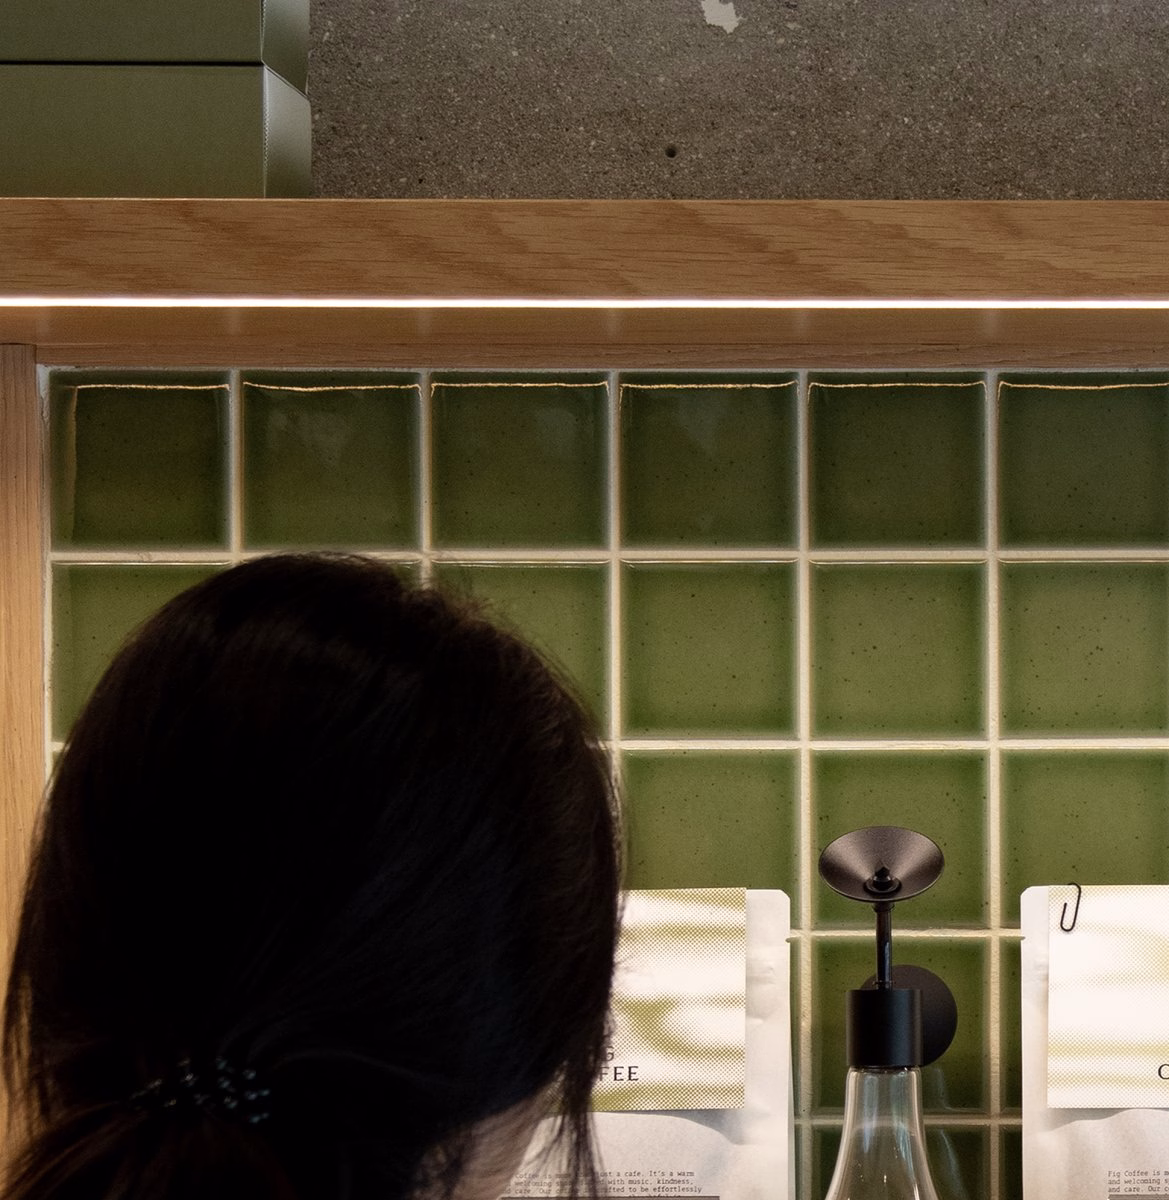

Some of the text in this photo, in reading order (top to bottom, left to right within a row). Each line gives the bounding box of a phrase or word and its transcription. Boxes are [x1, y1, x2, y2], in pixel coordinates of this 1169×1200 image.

[598, 1065, 639, 1082] FEE
[1108, 1170, 1120, 1179] Fig
[1124, 1178, 1160, 1186] welcoming
